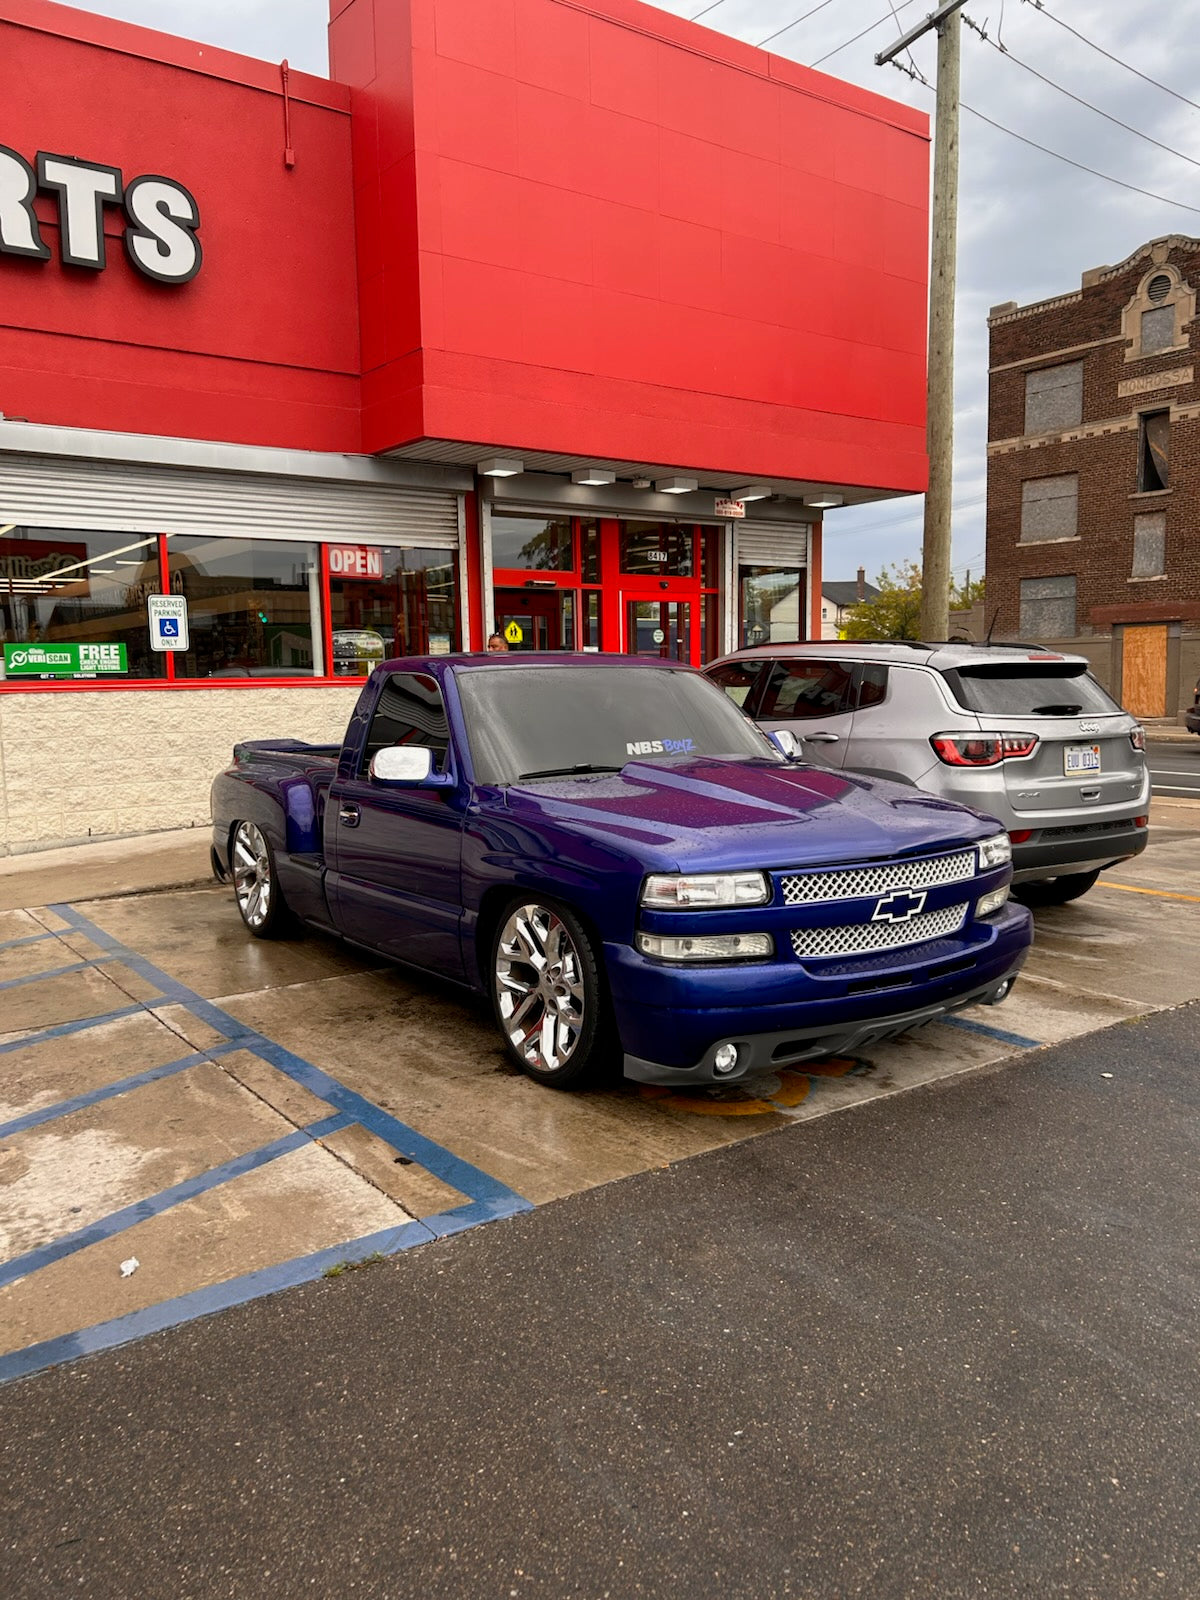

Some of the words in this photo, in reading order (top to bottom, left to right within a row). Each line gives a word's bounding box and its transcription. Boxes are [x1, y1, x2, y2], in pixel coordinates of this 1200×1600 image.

[1119, 368, 1190, 393] MONROSSA
[330, 549, 380, 574] OPEN
[648, 552, 667, 561] 8417
[151, 600, 183, 608] RESERVED
[154, 609, 182, 617] PARKING
[161, 639, 178, 647] ONLY
[79, 645, 119, 660] FREE
[28, 654, 46, 663] VERI
[48, 655, 69, 663] SCAN
[1080, 721, 1100, 733] Jeep
[626, 741, 663, 755] NBS
